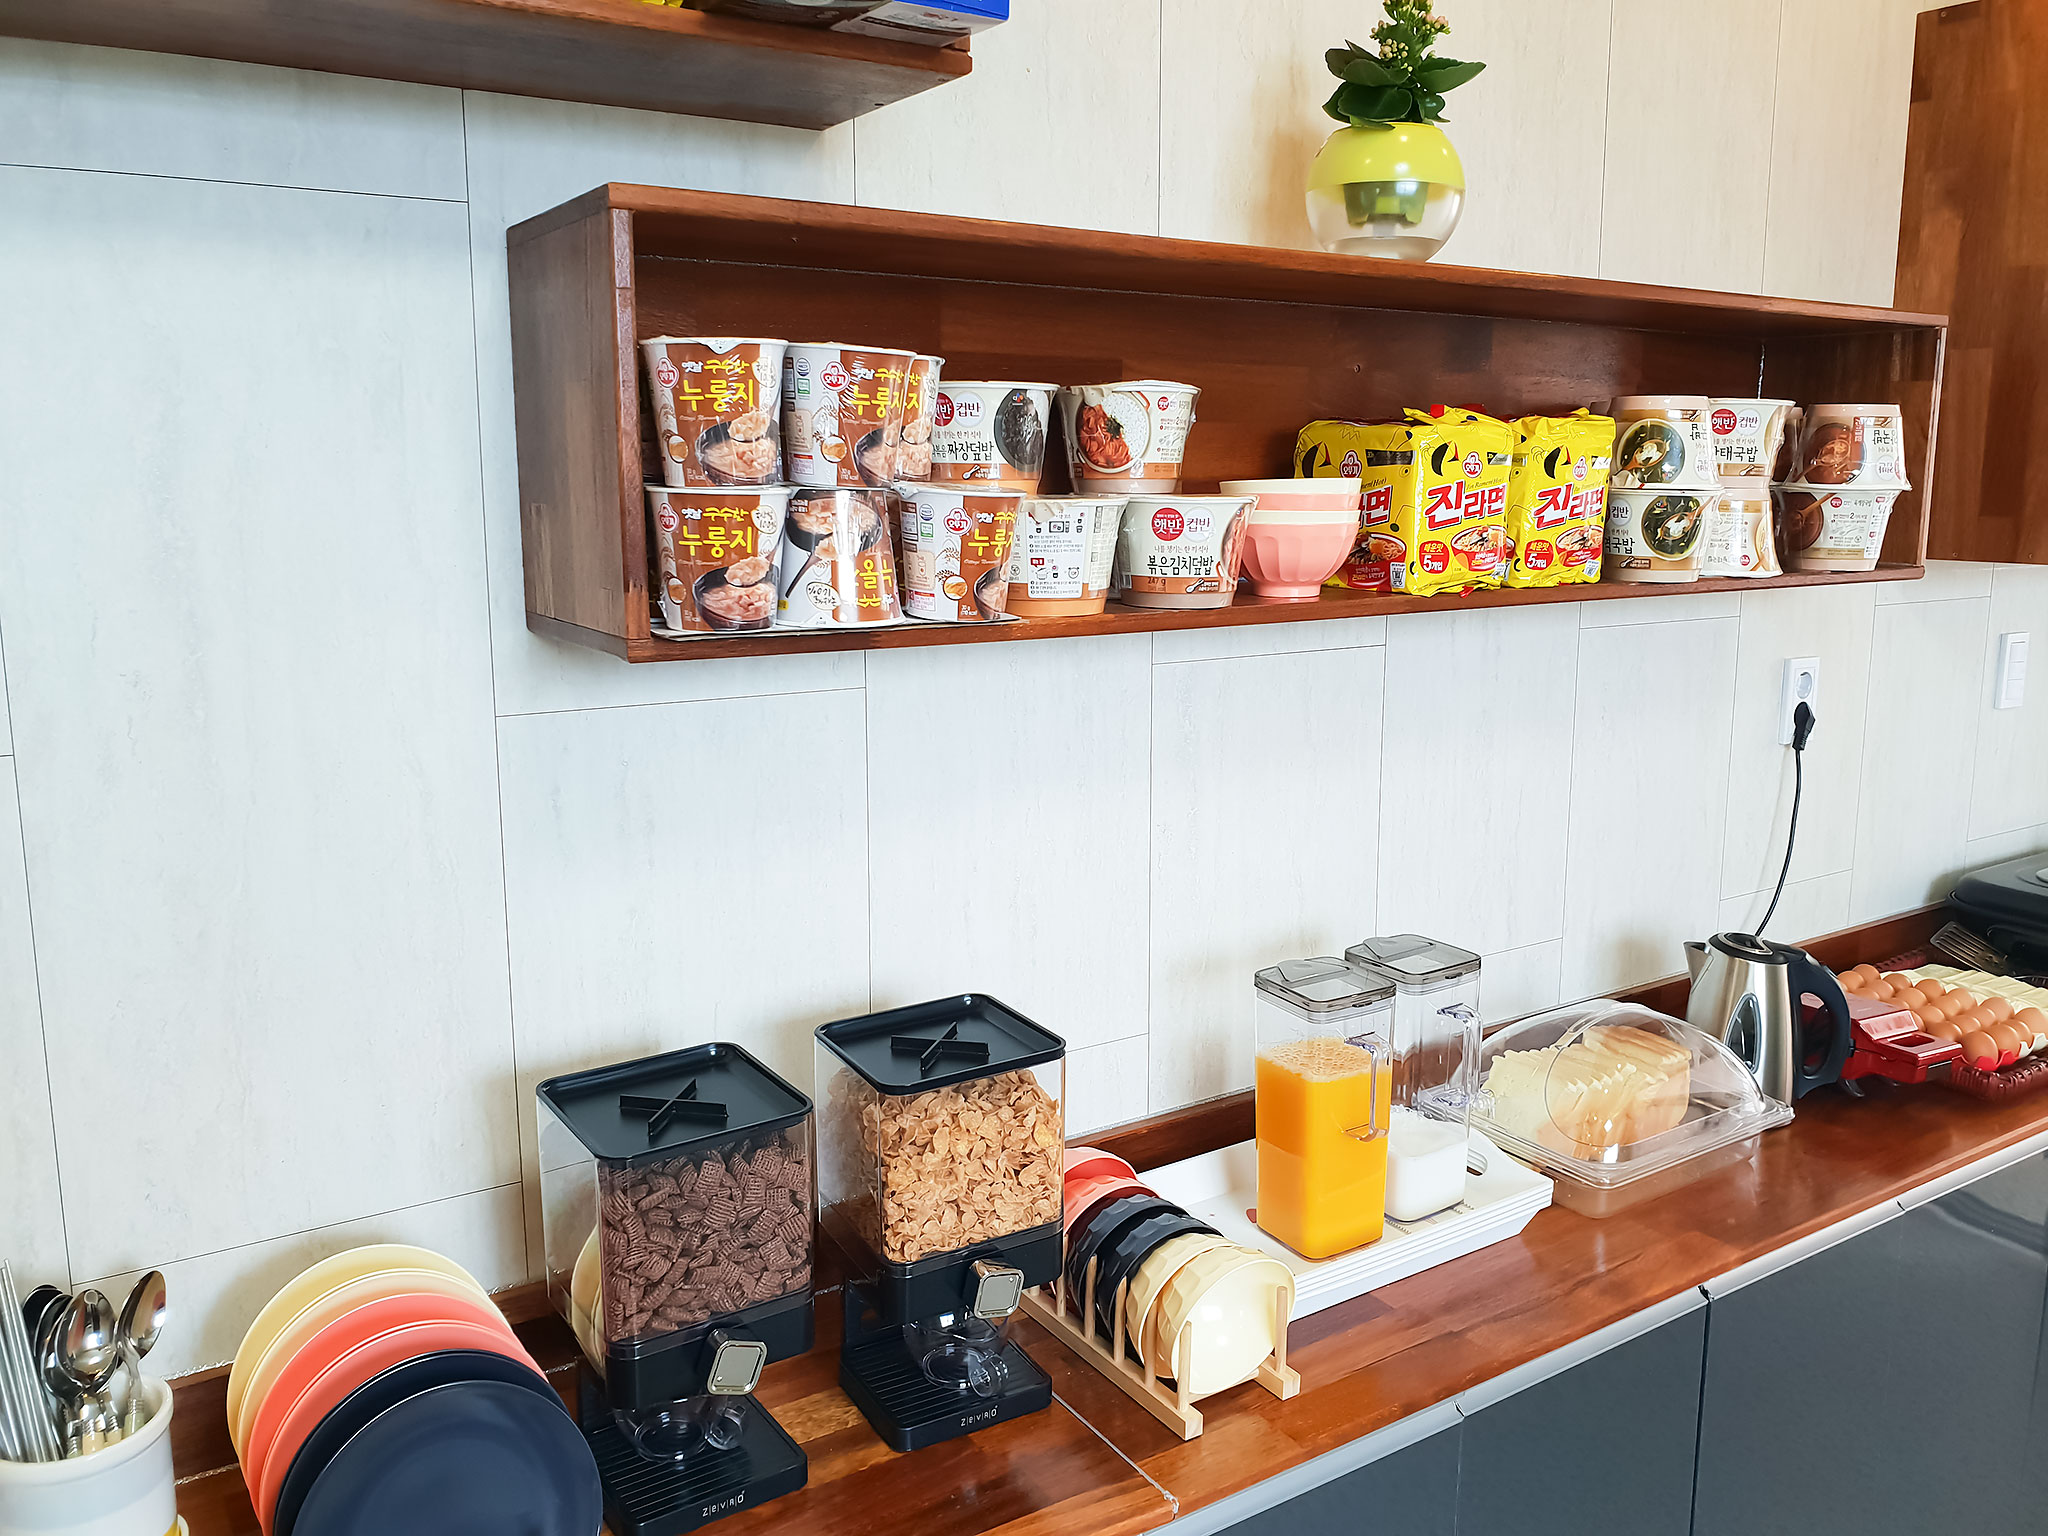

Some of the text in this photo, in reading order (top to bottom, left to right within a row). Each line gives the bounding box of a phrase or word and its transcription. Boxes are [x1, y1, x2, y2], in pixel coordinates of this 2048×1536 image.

[823, 374, 847, 388] 오뚜기
[679, 379, 753, 413] 누룽지
[957, 402, 982, 418] 컵반
[1739, 416, 1758, 428] 컵반
[1343, 465, 1359, 475] 오뚜기
[1425, 481, 1507, 529] 진라면
[1533, 484, 1605, 530] 진라면
[1611, 506, 1628, 518] 컵반
[703, 507, 749, 522] 구수한
[947, 519, 968, 531] 오뚜기
[1153, 518, 1210, 534] 햇반 컵반
[678, 525, 752, 558] 누룽지
[1423, 543, 1444, 552] 매운맛
